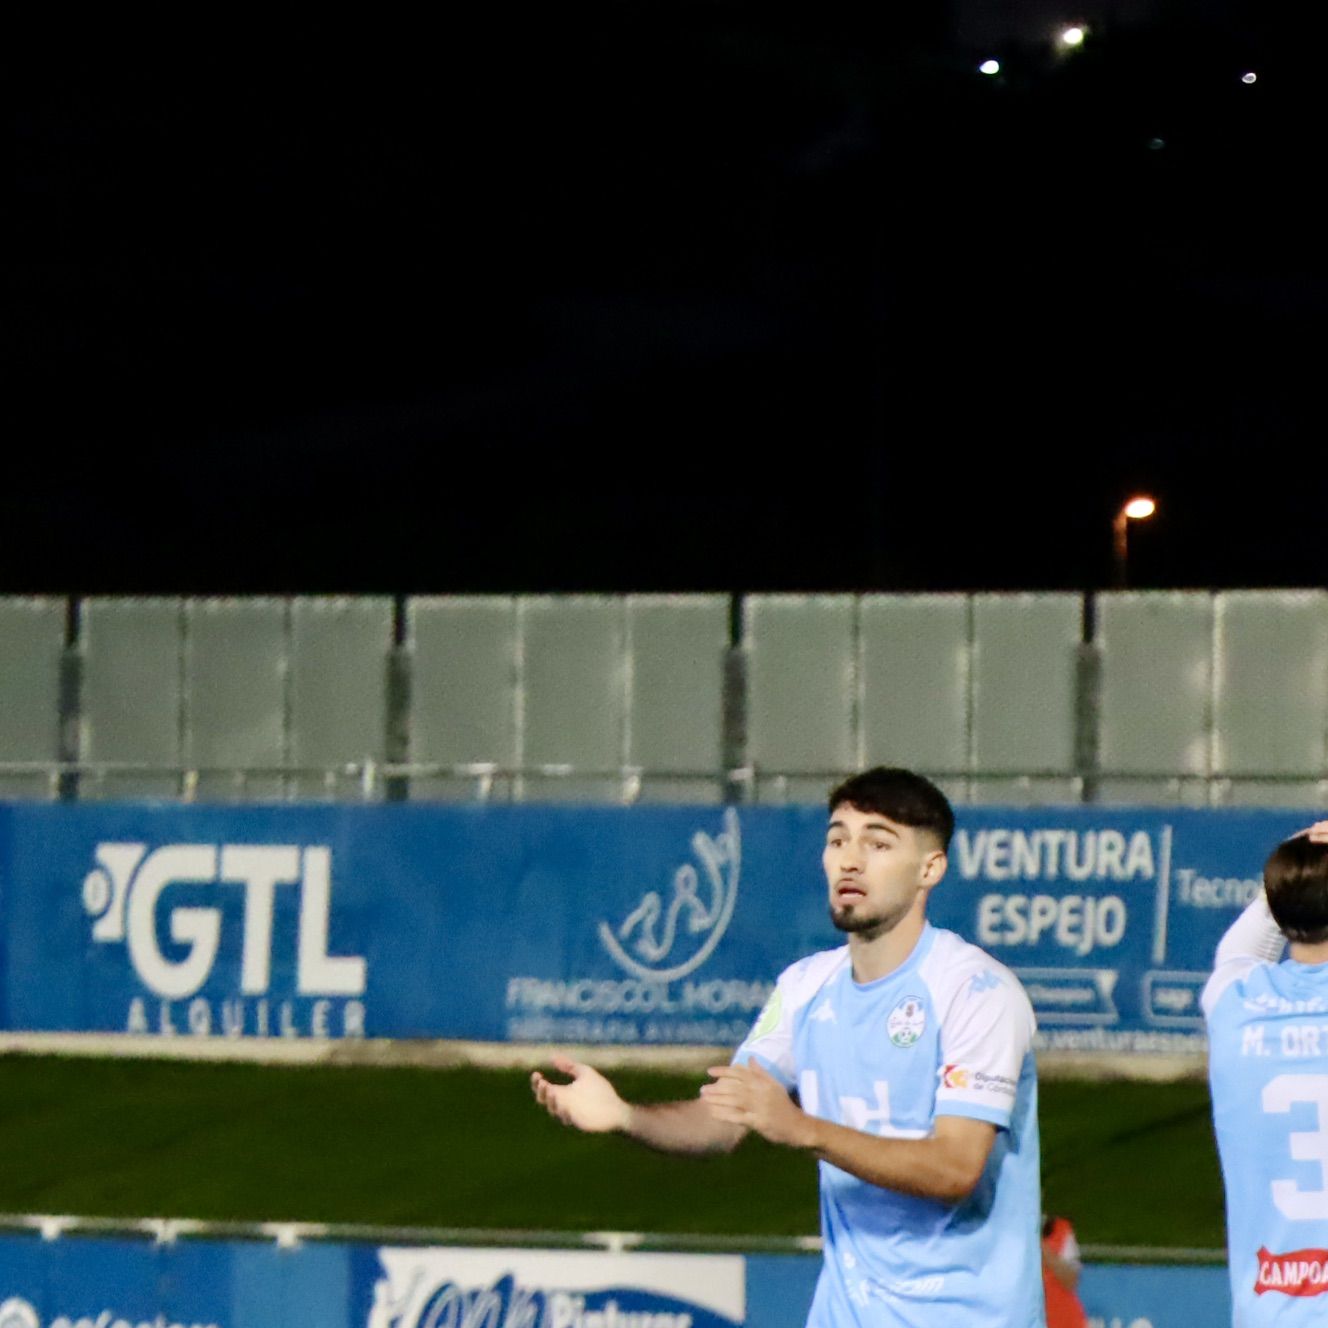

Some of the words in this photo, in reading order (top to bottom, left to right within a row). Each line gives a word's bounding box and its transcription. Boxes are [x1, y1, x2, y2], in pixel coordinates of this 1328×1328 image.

[955, 829, 1155, 881] VENTURA
[127, 844, 366, 999] GTL
[978, 894, 1127, 956] ESPEJO
[127, 1000, 366, 1039] ALQUILER
